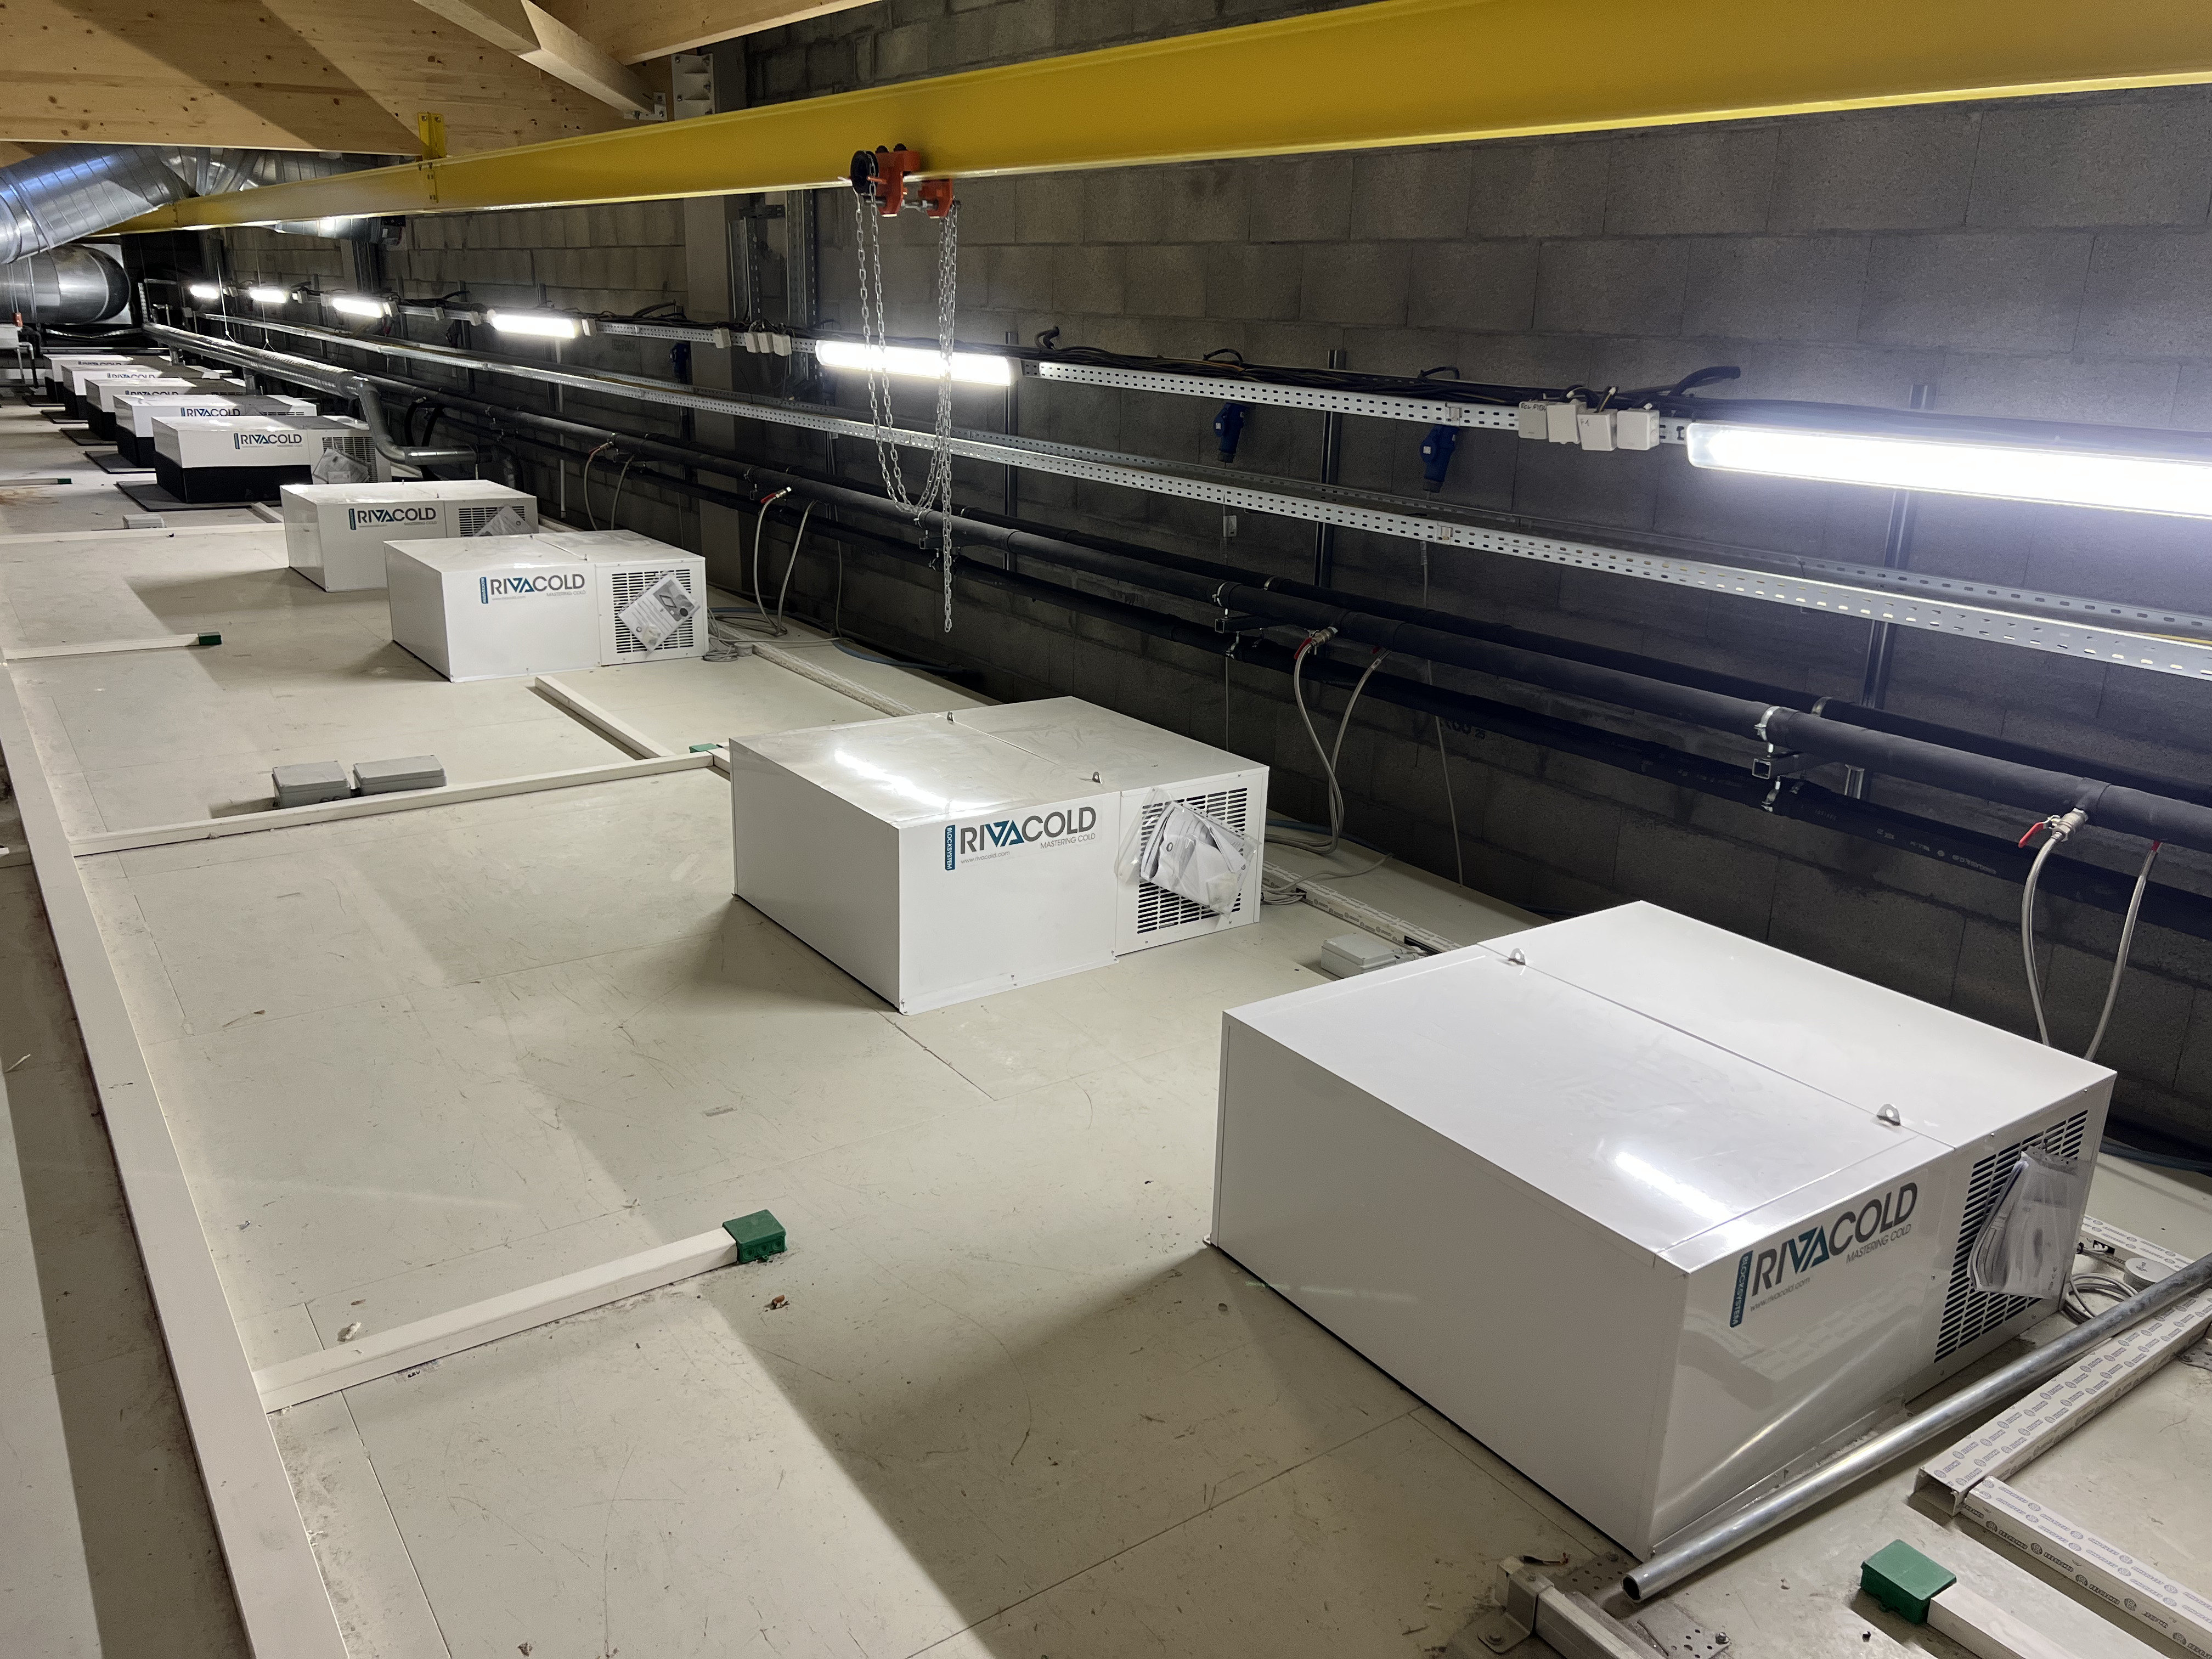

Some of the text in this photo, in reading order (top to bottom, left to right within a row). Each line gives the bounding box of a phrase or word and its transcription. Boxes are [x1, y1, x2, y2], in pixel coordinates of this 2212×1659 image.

[187, 408, 241, 416] RIVACOLD
[240, 434, 302, 444] RIVACOLD
[357, 507, 437, 523] RIVACOLD
[490, 574, 585, 595] RIVACOLD
[960, 806, 1096, 854] RIVACOLD
[1040, 833, 1096, 849] MASTERING COLD
[961, 850, 1010, 864] www.rivacold.com
[1752, 1182, 1917, 1297] RIVACOLD
[1846, 1223, 1911, 1263] MASTERING COLD
[1732, 1256, 1749, 1325] BLOCKSYSTEM
[1750, 1277, 1810, 1312] www.rivacold.com
